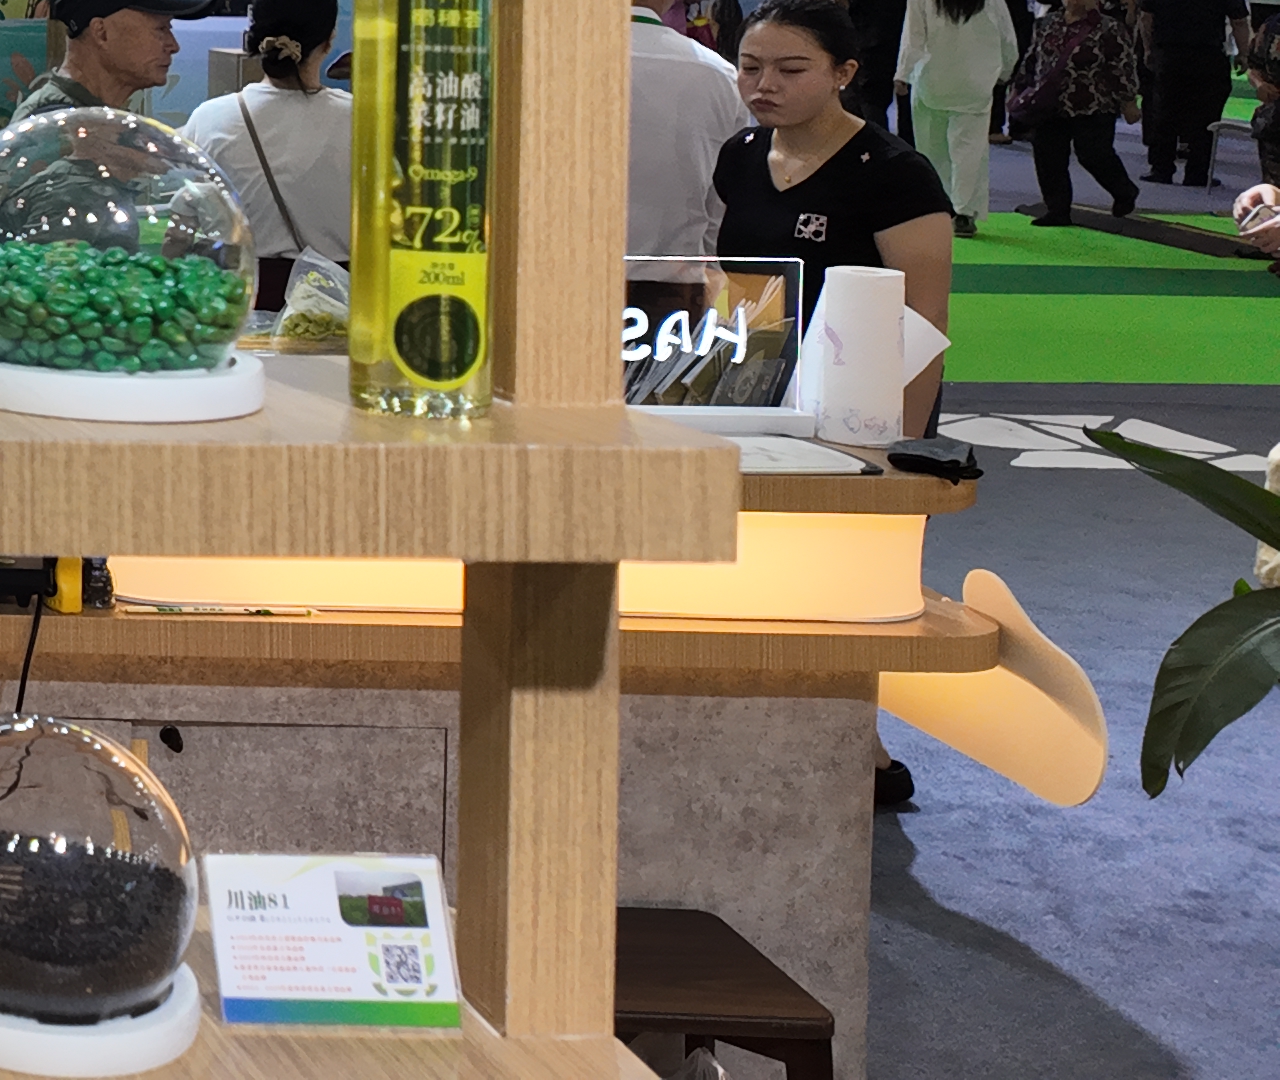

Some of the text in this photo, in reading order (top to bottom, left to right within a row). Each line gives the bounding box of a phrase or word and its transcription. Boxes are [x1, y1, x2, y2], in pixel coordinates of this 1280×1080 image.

[409, 70, 482, 100] 高油酸
[408, 165, 479, 182] Omega-9
[406, 207, 483, 254] 72%
[227, 889, 291, 911] 川油81
